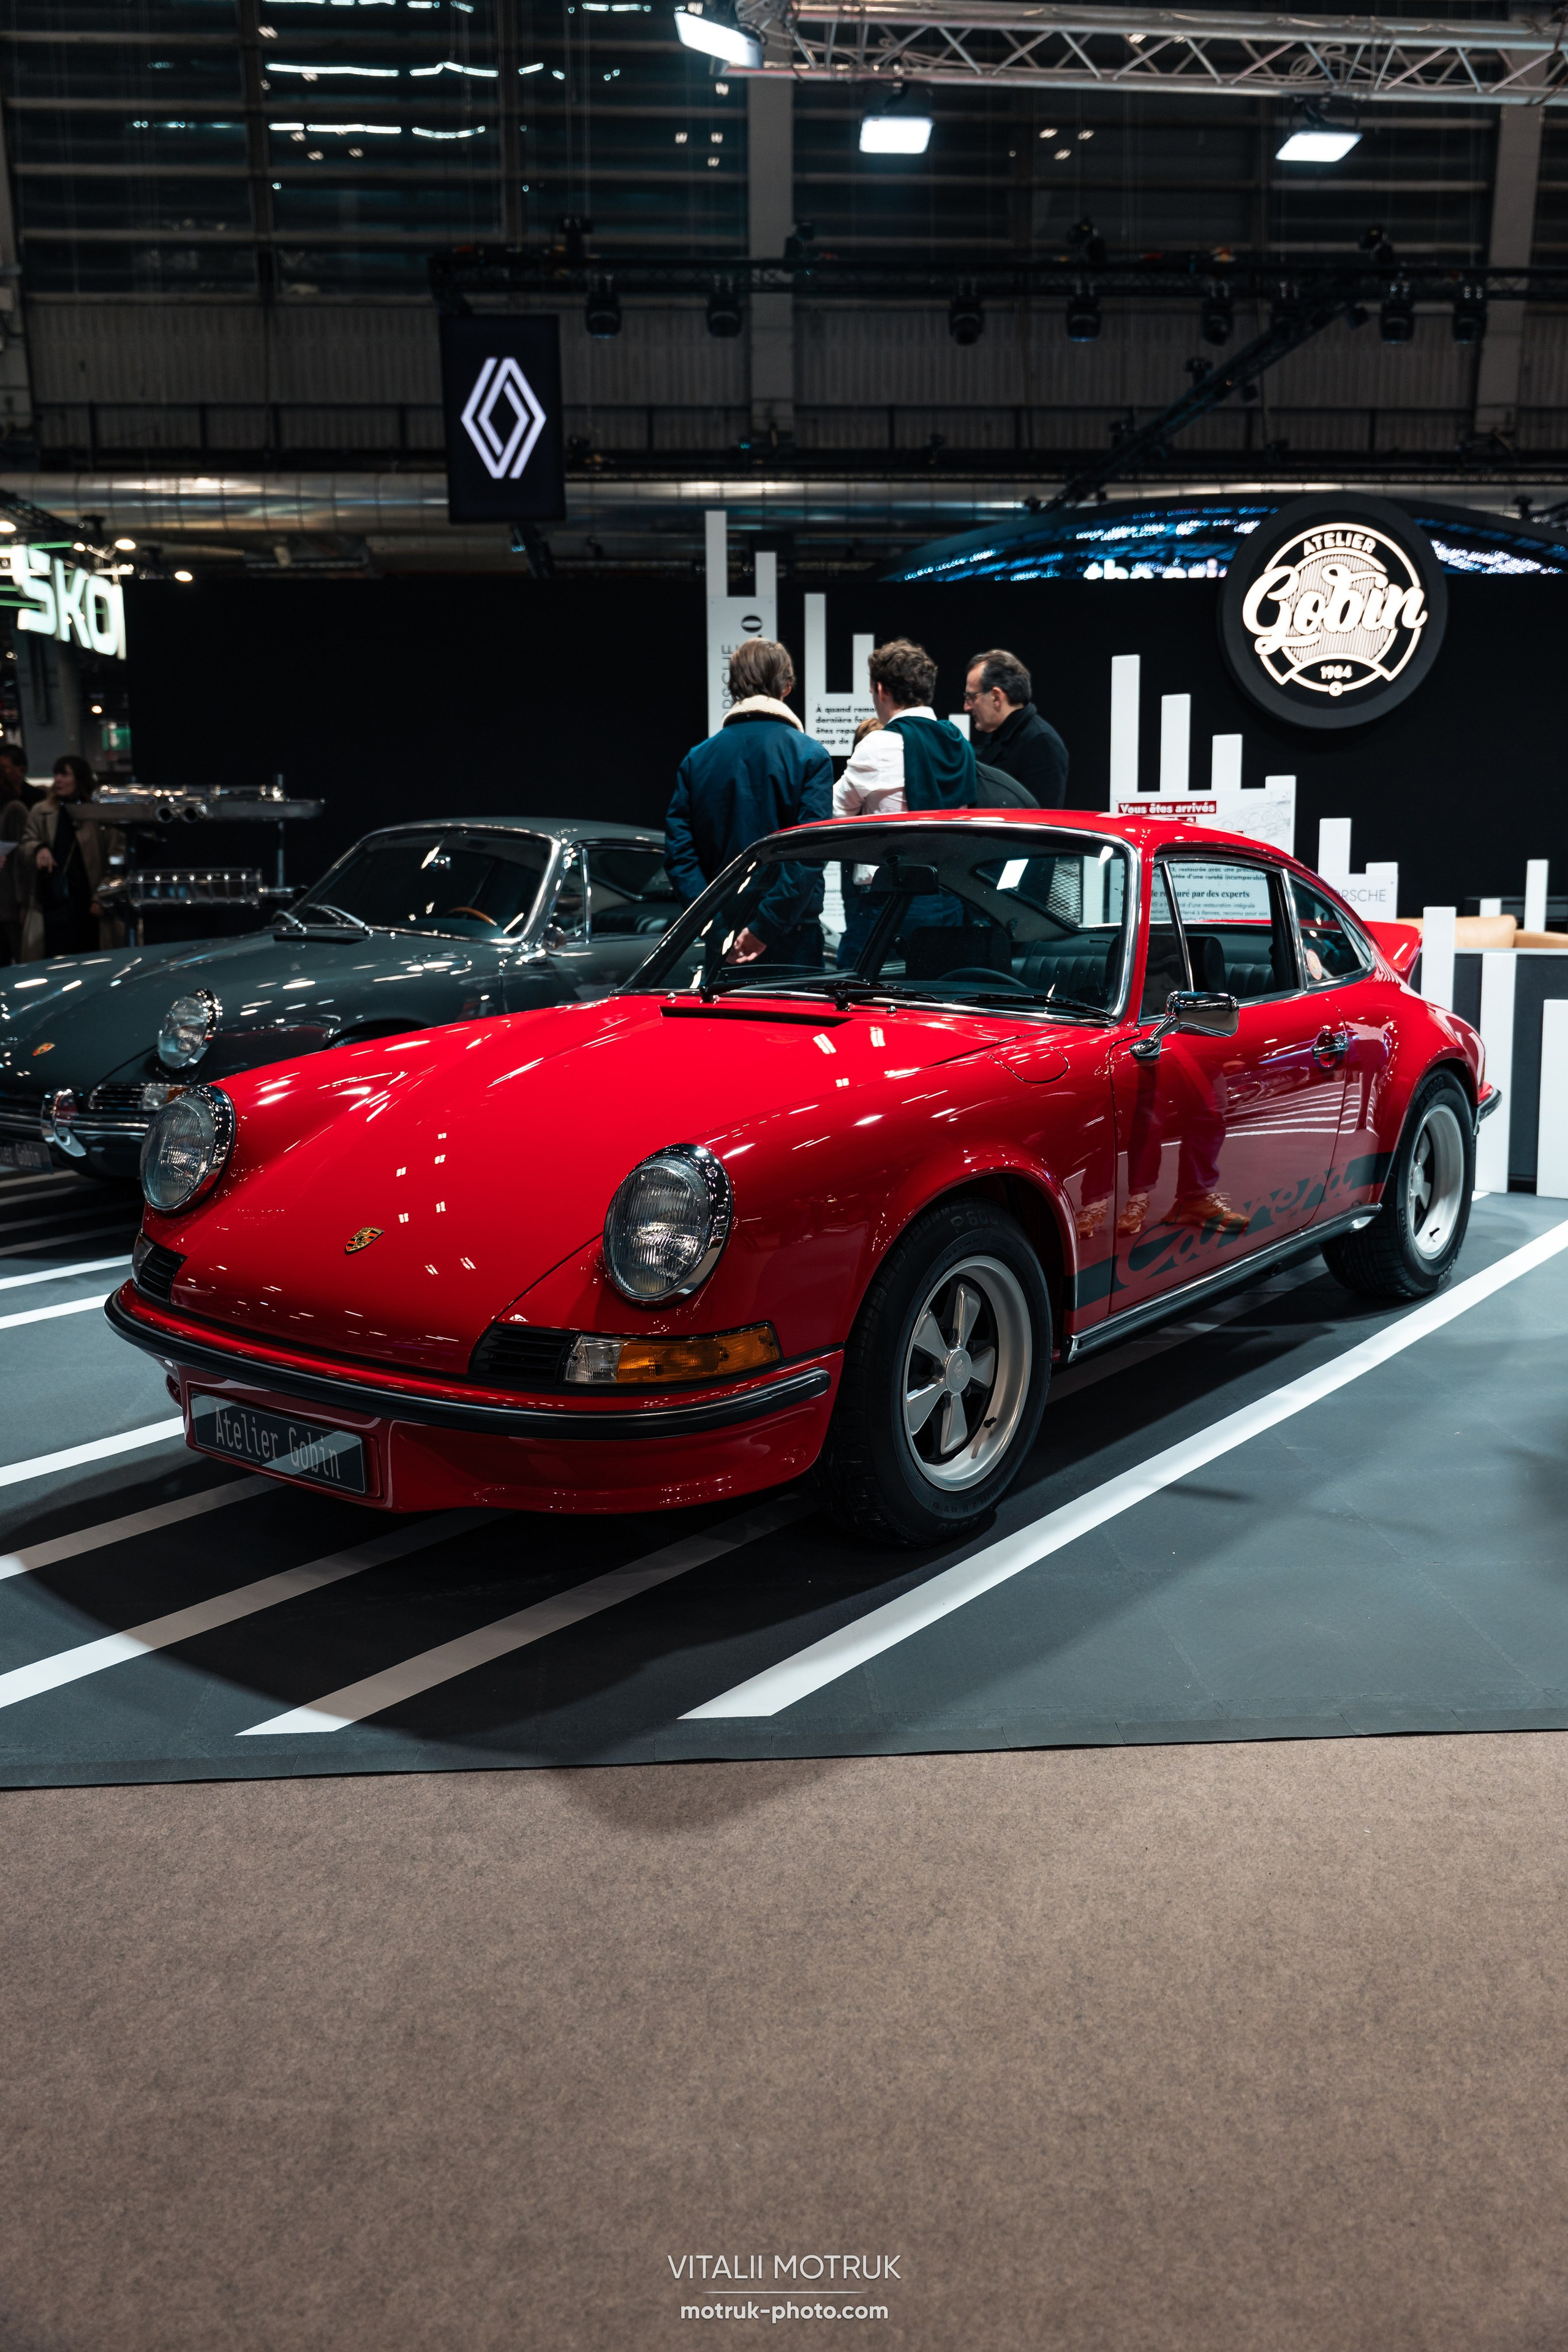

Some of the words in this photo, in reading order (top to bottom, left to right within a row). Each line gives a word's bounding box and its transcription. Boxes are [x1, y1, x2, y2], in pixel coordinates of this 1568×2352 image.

[1303, 531, 1376, 556] ATELIER
[1242, 563, 1428, 656] Gobin
[824, 706, 852, 714] quand
[1120, 804, 1146, 815] Vous
[1148, 802, 1173, 814] êtes
[1175, 801, 1216, 813] arrivés
[1206, 889, 1219, 898] des
[1221, 891, 1250, 900] experts
[1335, 889, 1386, 902] RSCHE
[1116, 1162, 1351, 1287] Carrera
[215, 1406, 279, 1461] Atelier
[288, 1427, 341, 1480] Gobin
